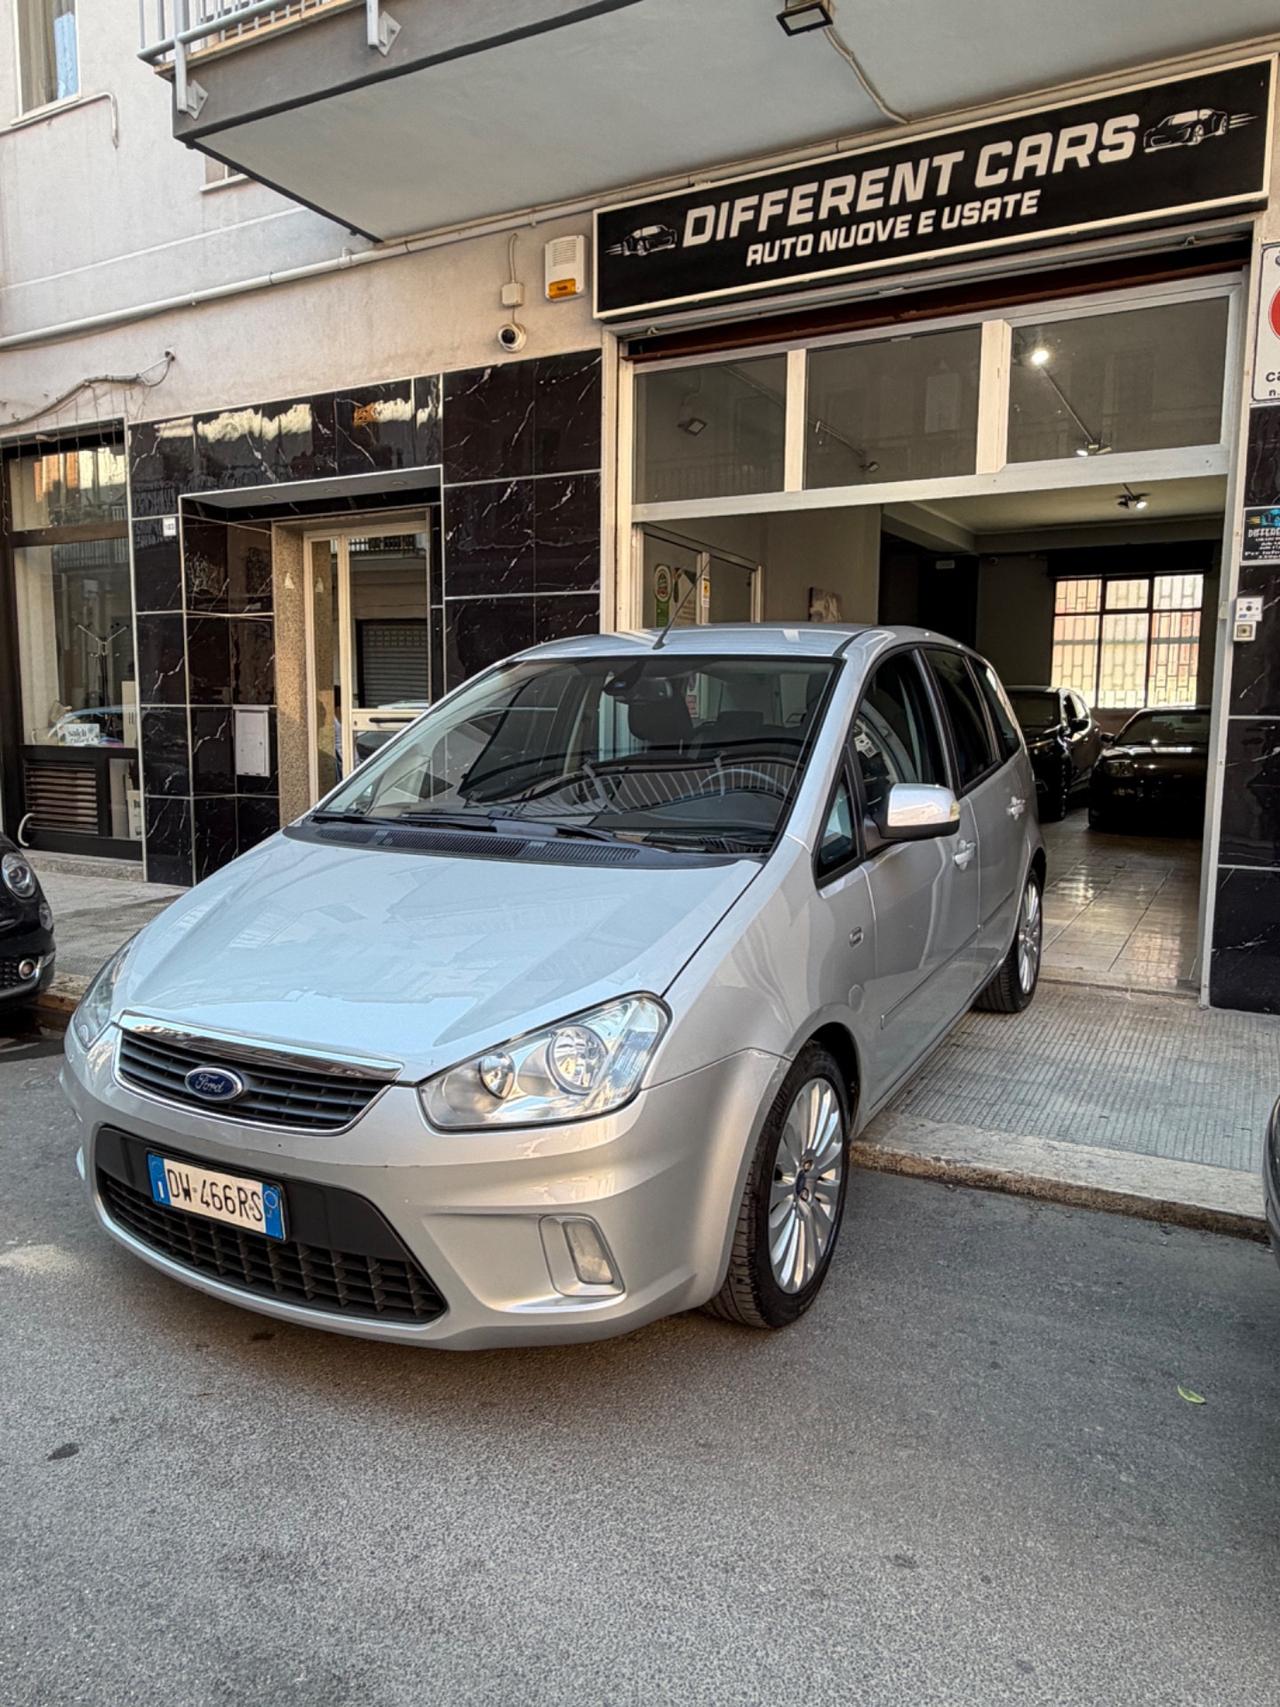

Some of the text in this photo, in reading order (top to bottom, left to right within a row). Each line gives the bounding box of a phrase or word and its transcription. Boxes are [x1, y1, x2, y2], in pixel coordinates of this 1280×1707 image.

[682, 113, 1140, 248] DIFFERENT CARS
[746, 189, 1041, 267] AUTO NUOVE E USATE
[194, 1073, 225, 1093] Ford
